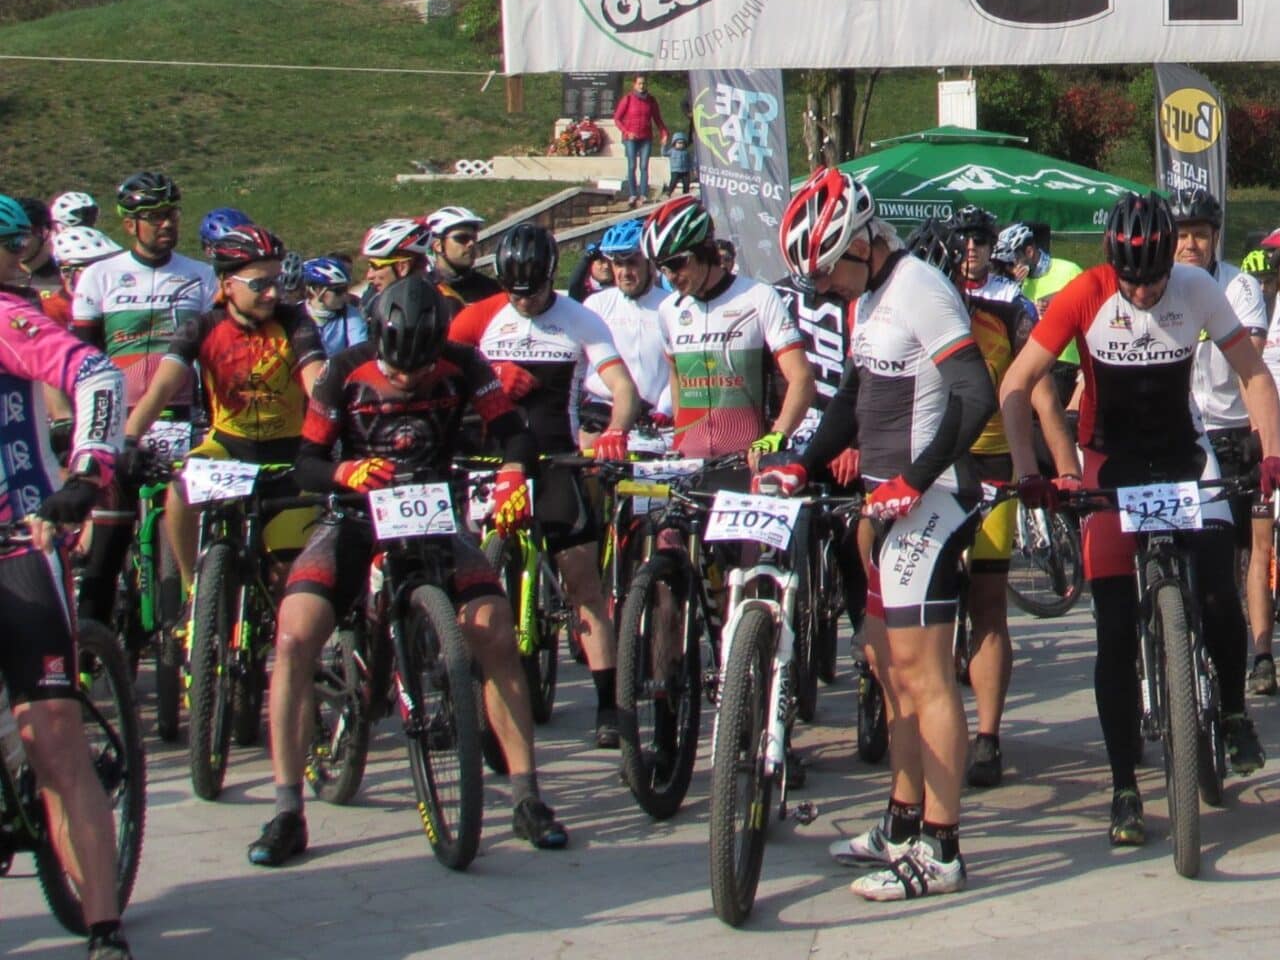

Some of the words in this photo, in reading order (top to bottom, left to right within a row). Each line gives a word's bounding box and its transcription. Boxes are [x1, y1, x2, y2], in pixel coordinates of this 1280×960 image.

[1096, 345, 1193, 362] REVOLUTION
[1108, 341, 1129, 351] BT
[399, 499, 428, 518] 60
[1139, 498, 1181, 518] 127
[727, 511, 777, 529] 107
